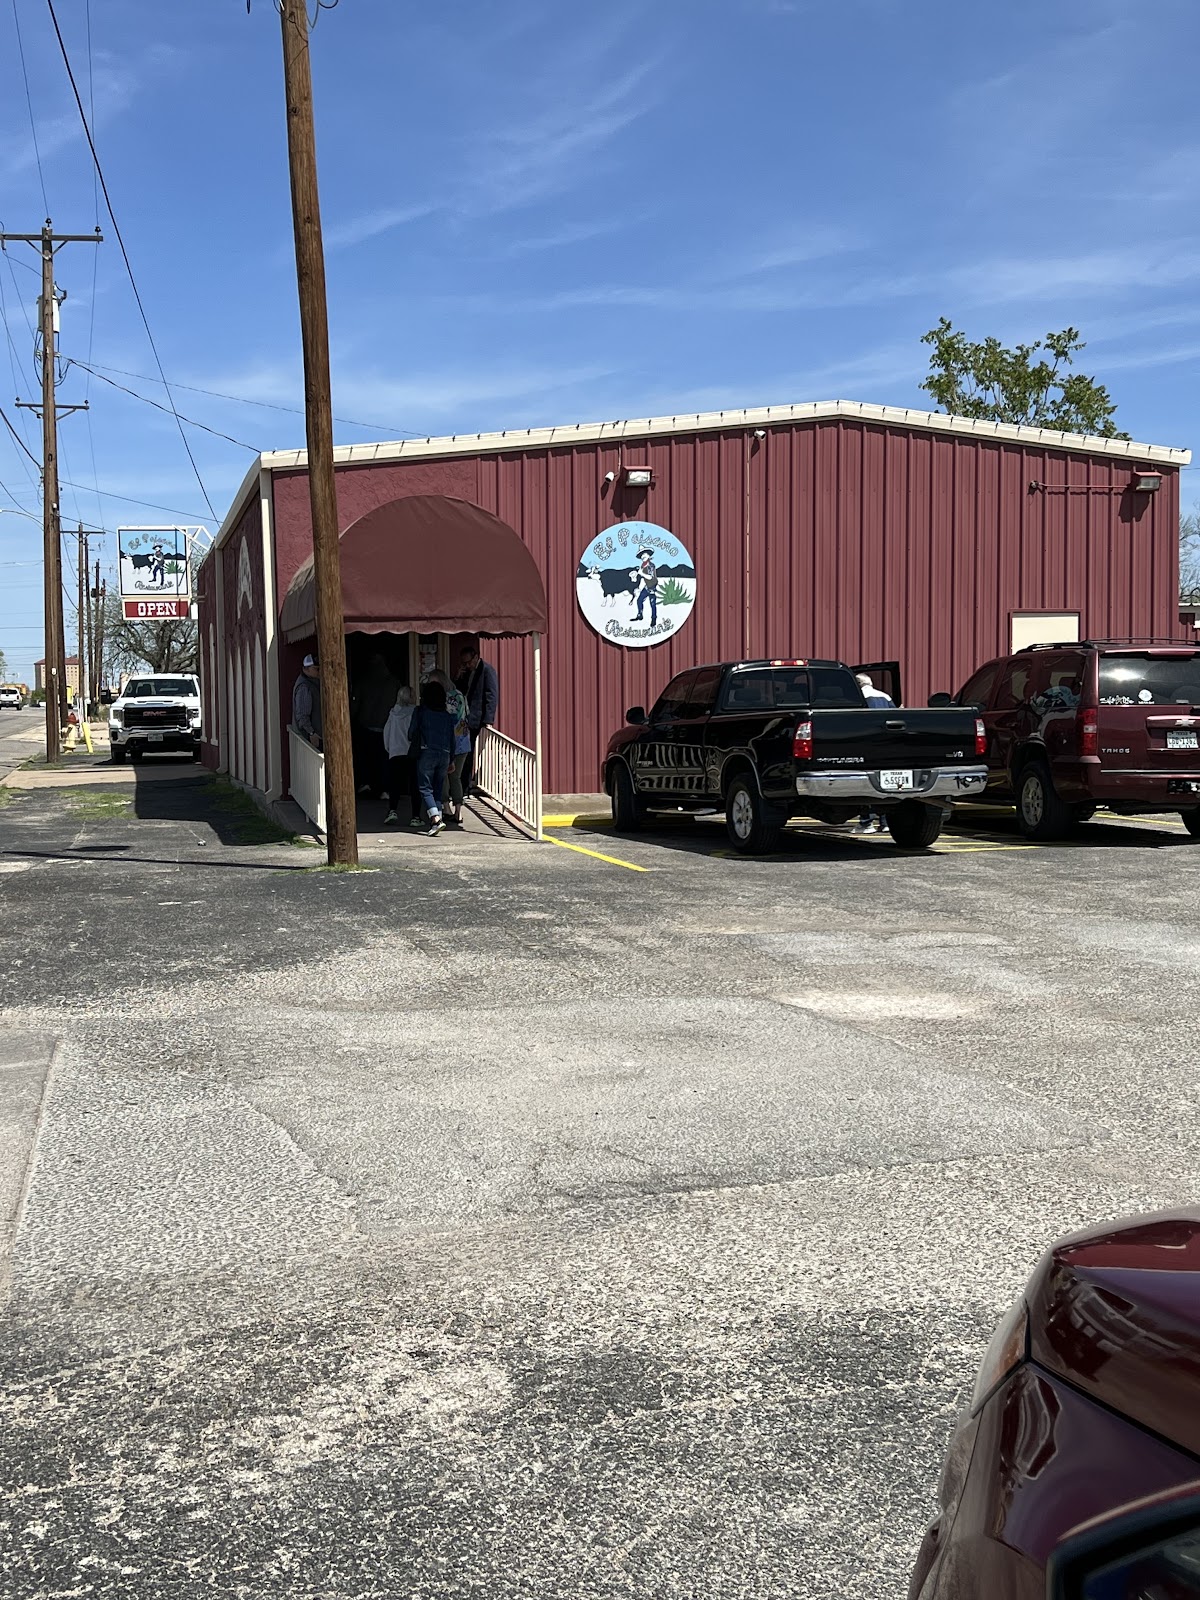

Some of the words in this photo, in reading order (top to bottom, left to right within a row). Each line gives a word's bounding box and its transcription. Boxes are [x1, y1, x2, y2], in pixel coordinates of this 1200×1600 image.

[593, 536, 617, 561] El
[617, 528, 679, 558] Paisano
[137, 602, 177, 616] OPEN
[831, 756, 865, 764] TUNDRA
